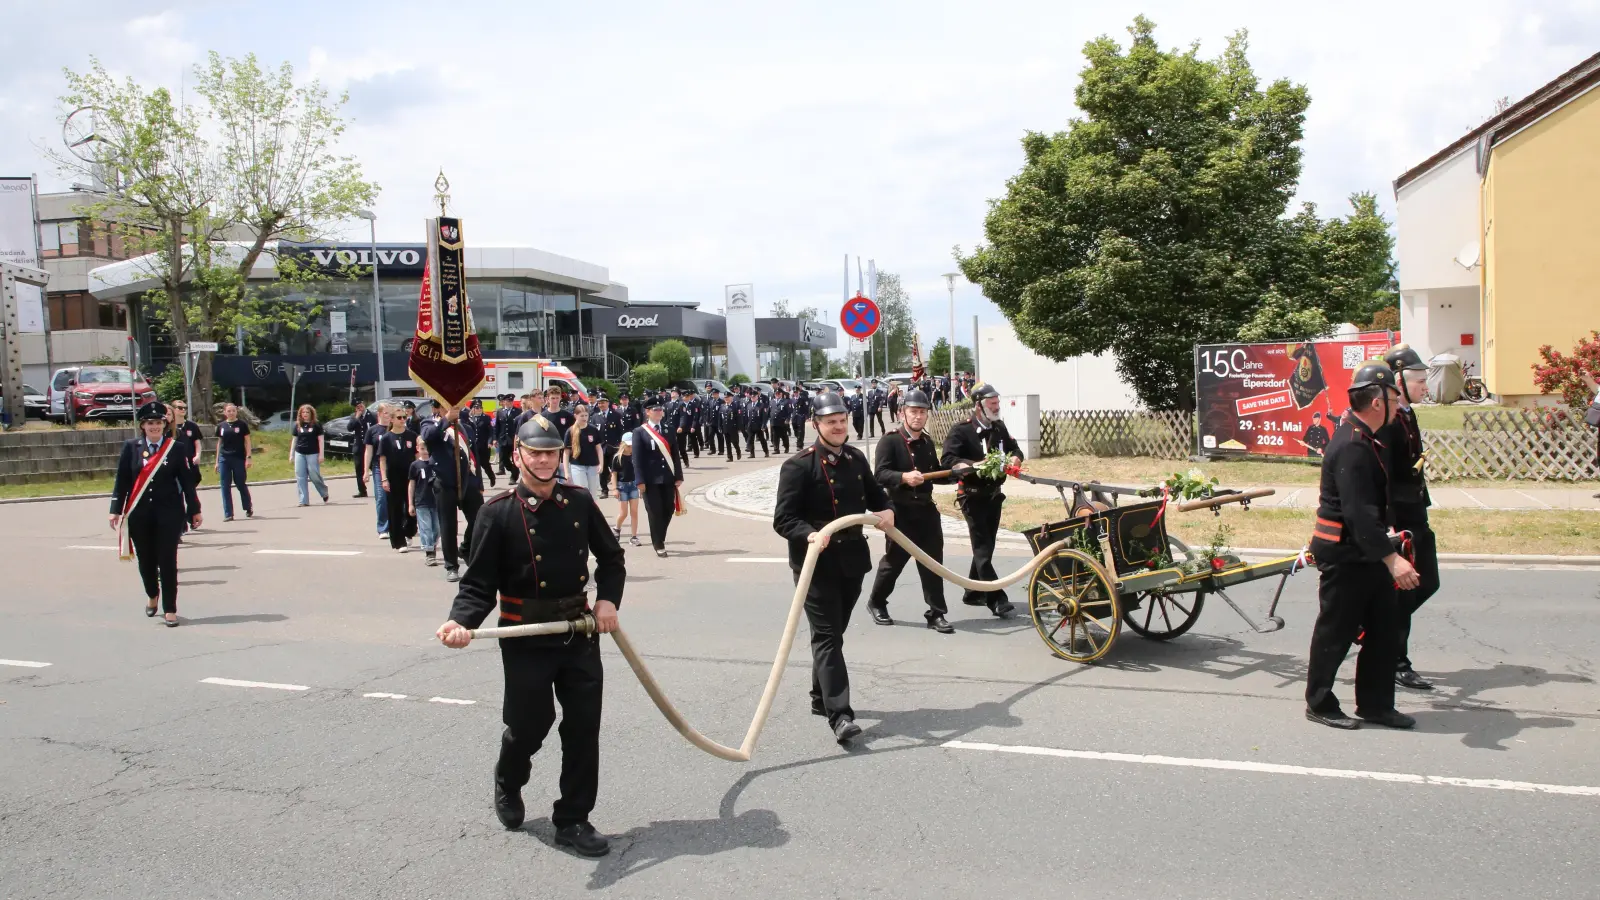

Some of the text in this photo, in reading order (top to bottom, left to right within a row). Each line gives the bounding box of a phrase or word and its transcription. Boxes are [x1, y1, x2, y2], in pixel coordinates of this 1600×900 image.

[310, 249, 420, 265] VOLVO
[617, 313, 659, 329] Oppel
[278, 363, 361, 373] PUGEOT
[1201, 349, 1264, 377] 150 Jahre
[1243, 379, 1286, 389] Elpersdorf
[1242, 396, 1286, 410] SAVE THE DATE
[1239, 420, 1256, 430] 29.
[1263, 421, 1281, 431] 31.
[1282, 421, 1302, 432] Mai
[1257, 435, 1284, 446] 2026
